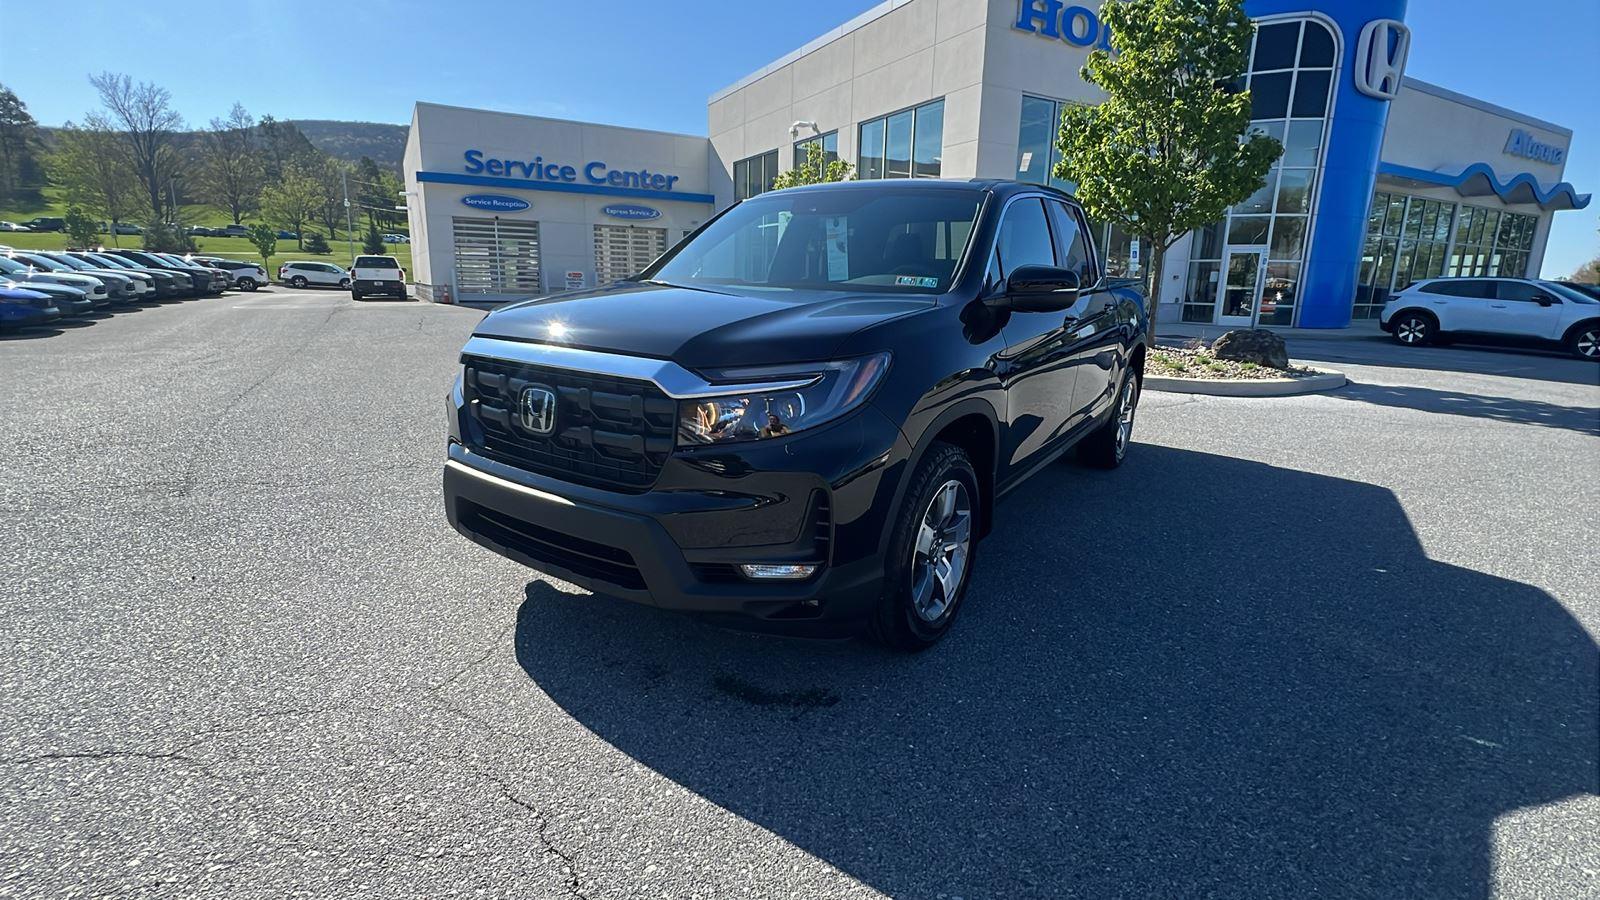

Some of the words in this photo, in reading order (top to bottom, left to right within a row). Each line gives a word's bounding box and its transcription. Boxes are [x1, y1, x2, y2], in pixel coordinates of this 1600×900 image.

[1503, 129, 1563, 165] Altoona
[464, 149, 577, 182] Service
[584, 161, 679, 191] Center
[465, 198, 492, 206] Service
[493, 200, 527, 208] Reception
[606, 207, 629, 216] Express
